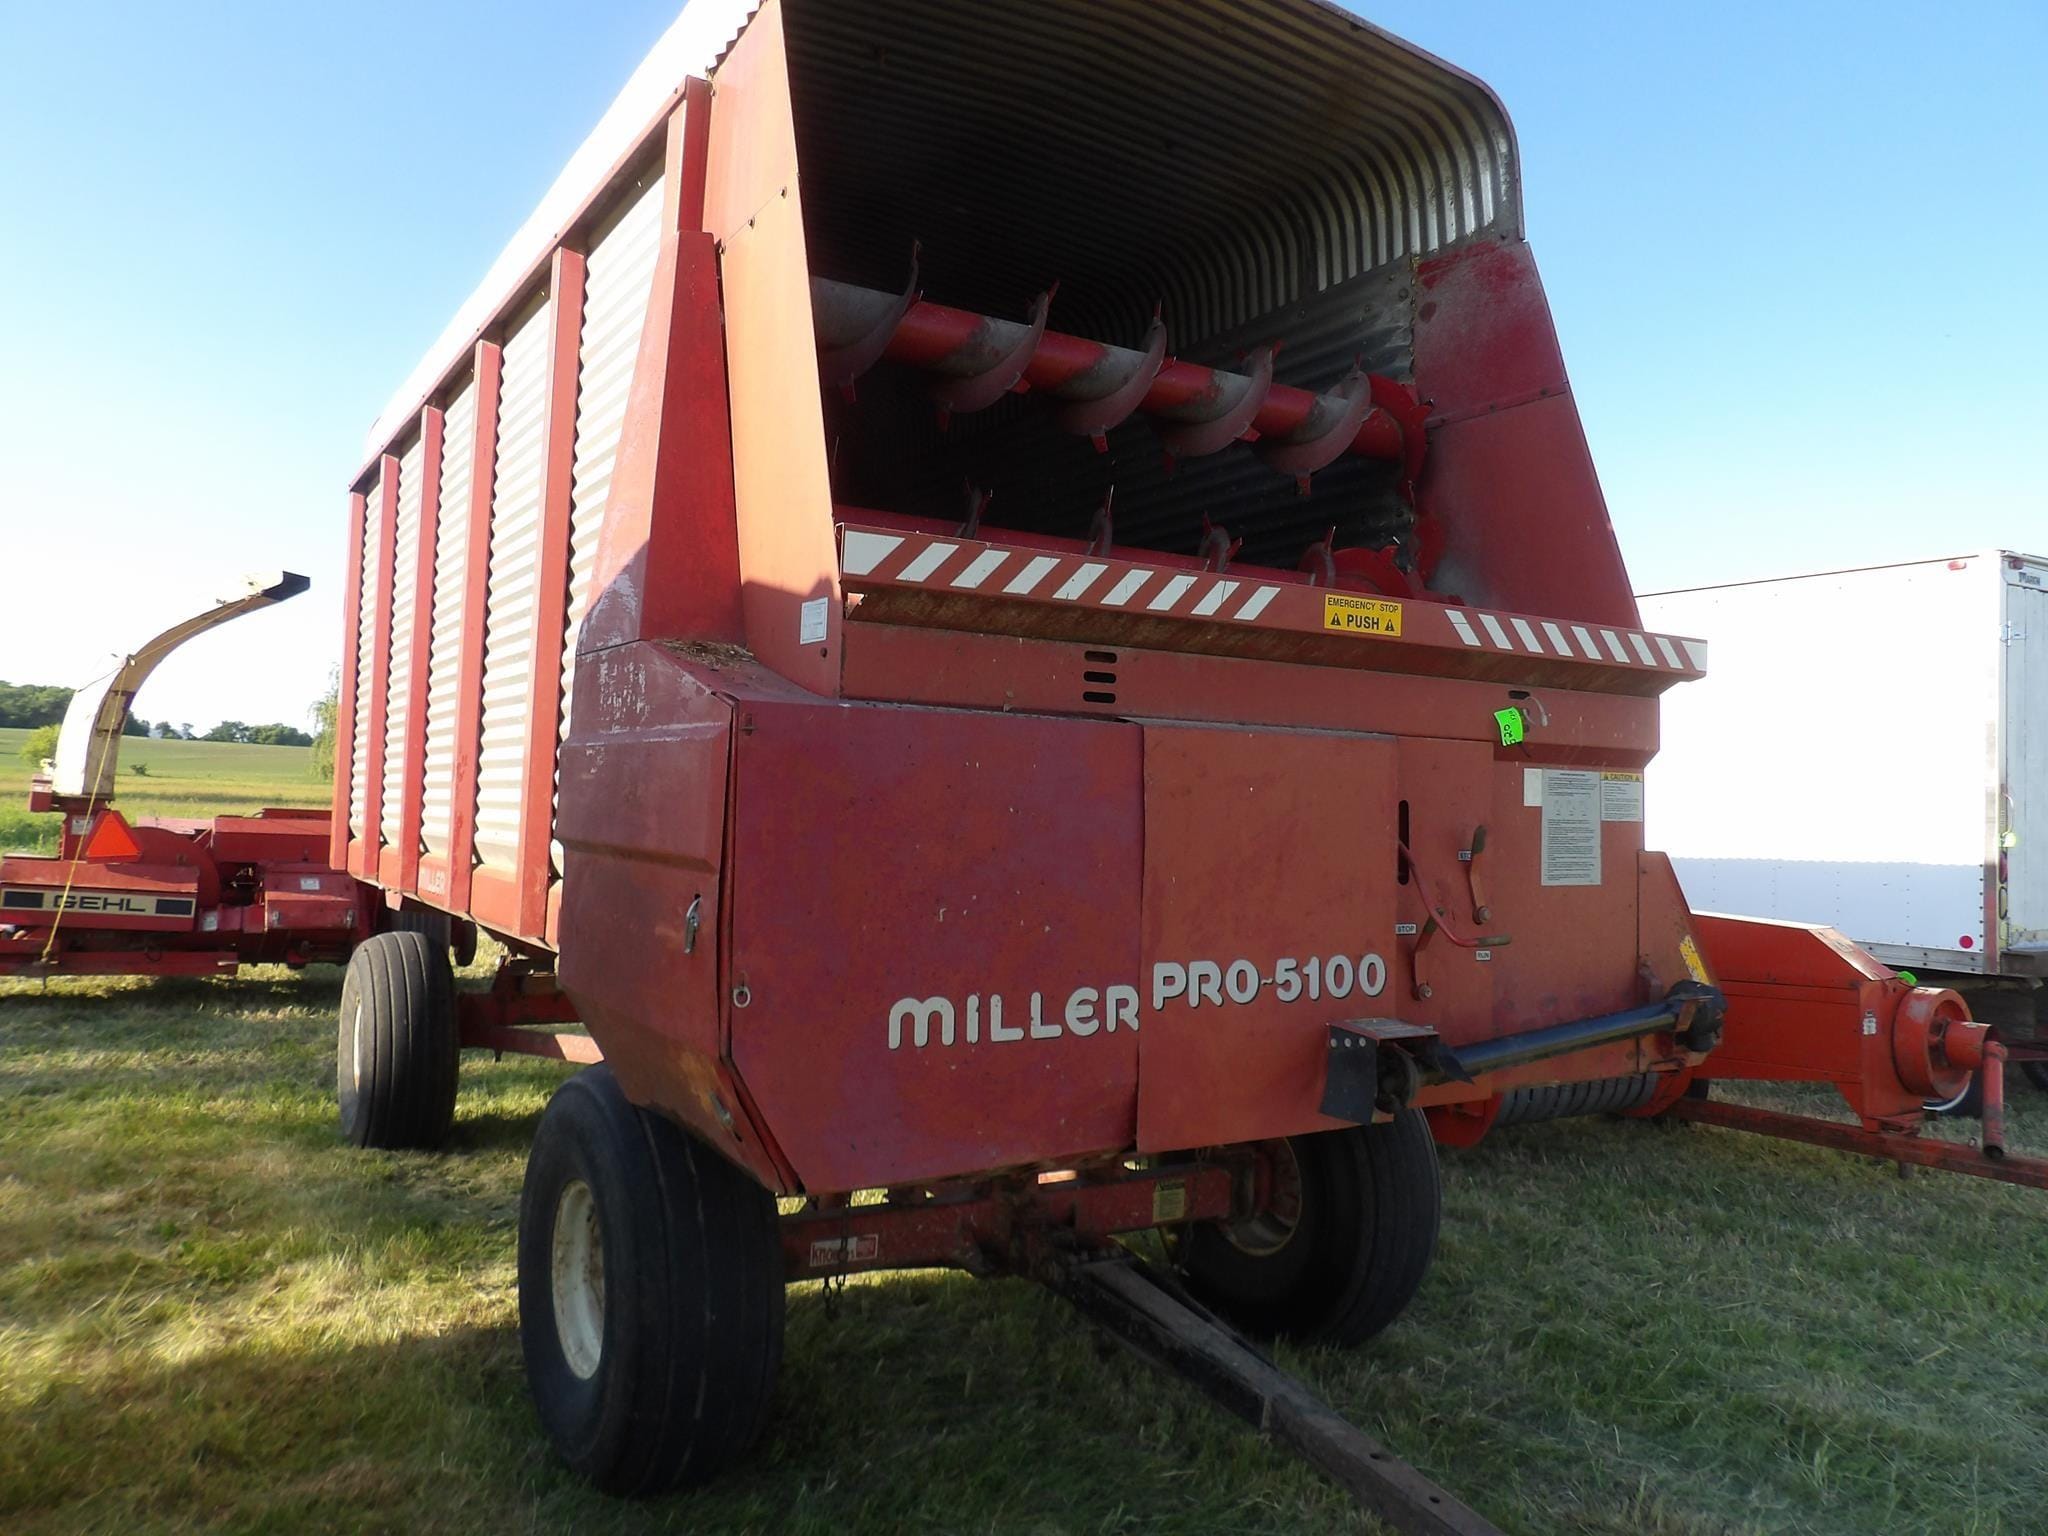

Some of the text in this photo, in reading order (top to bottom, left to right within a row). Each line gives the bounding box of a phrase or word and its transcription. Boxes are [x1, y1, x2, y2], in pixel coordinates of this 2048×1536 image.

[1327, 597, 1399, 613] EMERGENCY STOP
[1346, 613, 1380, 630] PUSH
[53, 894, 146, 912] GEHL
[1397, 925, 1415, 933] STOP
[887, 953, 1387, 1050] MILLER PRO-5100
